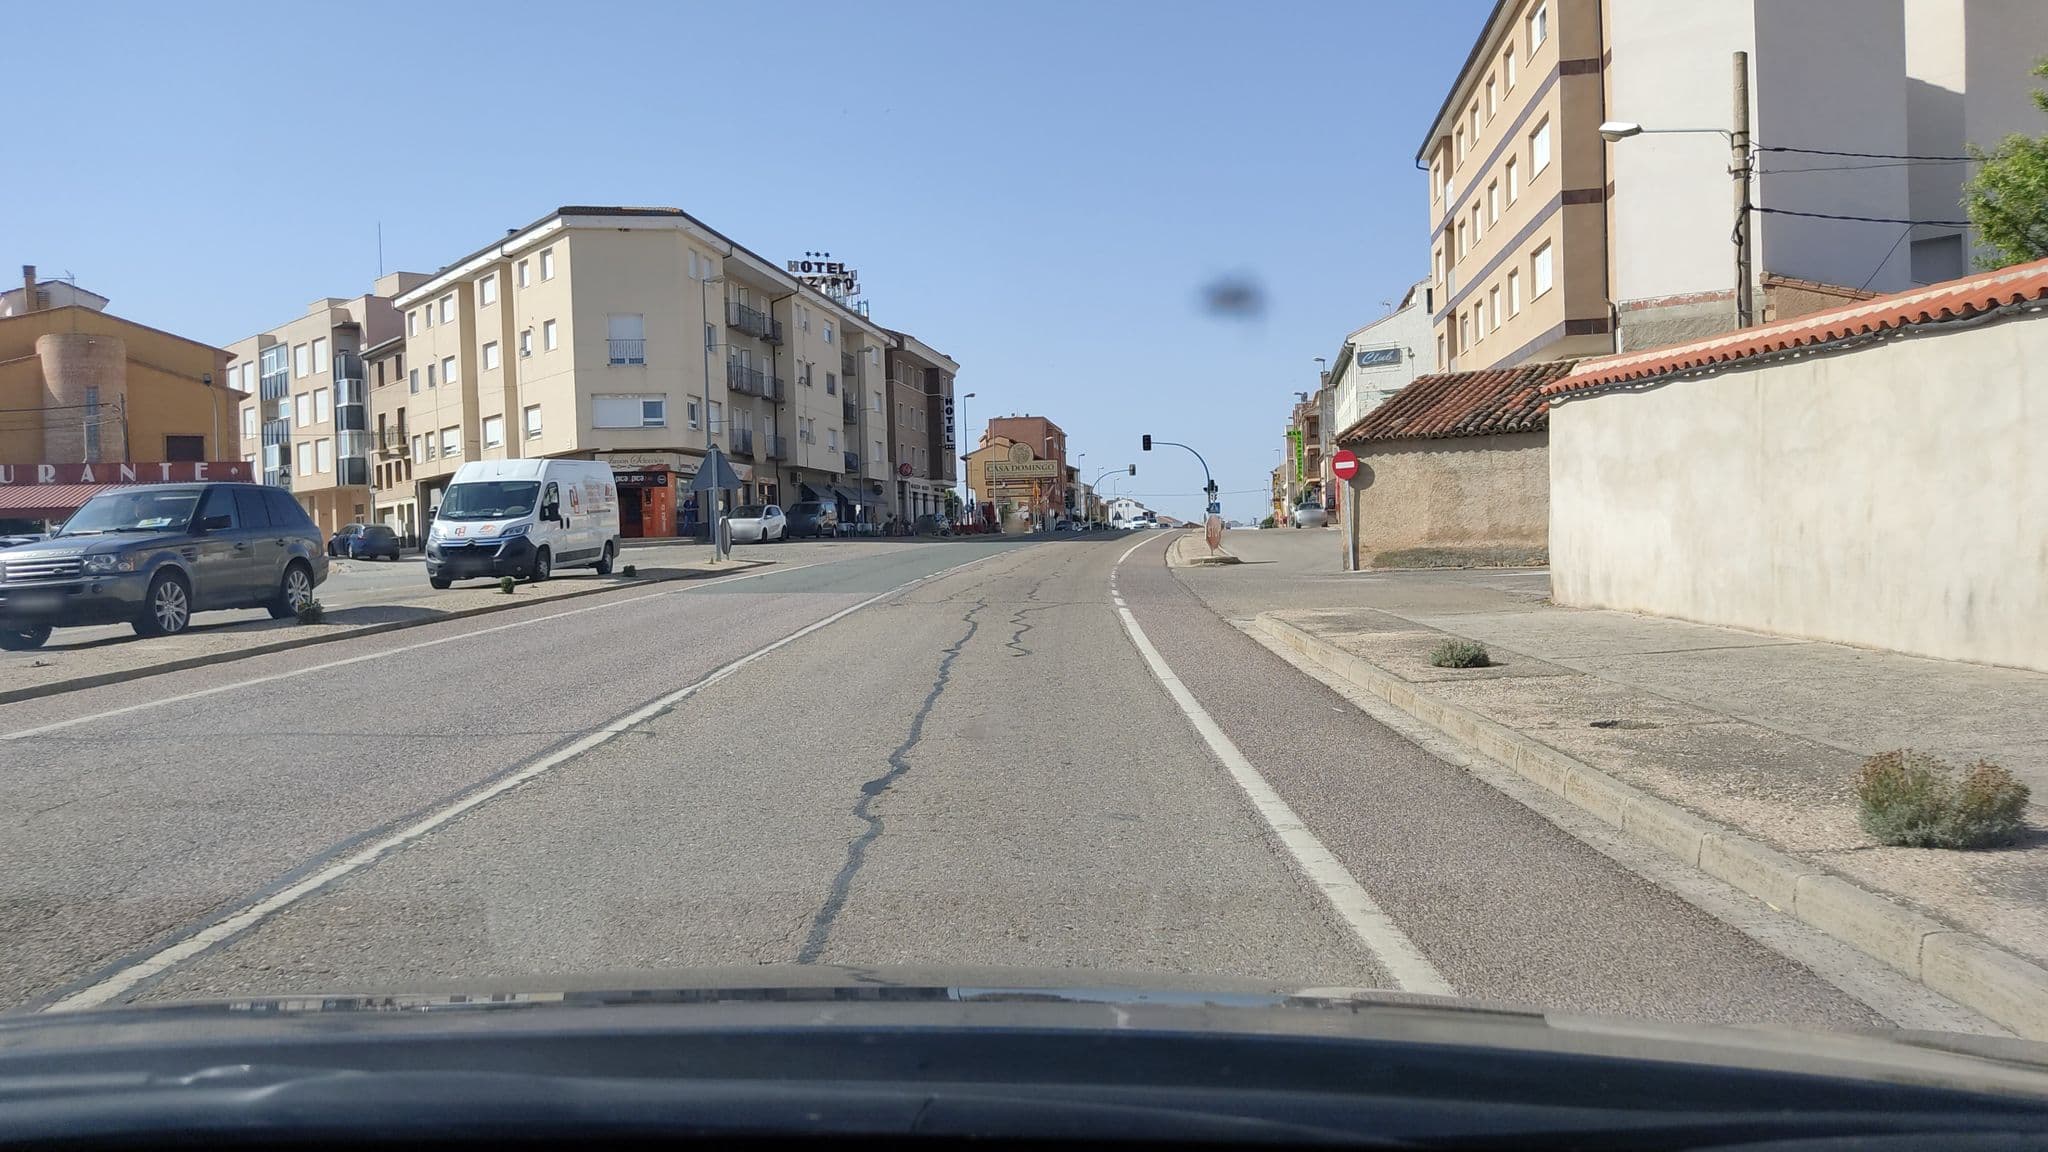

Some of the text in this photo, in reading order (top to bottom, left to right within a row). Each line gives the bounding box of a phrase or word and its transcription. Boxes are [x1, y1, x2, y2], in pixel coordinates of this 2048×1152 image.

[787, 260, 848, 275] HOTEL
[1361, 350, 1395, 365] Club
[945, 398, 953, 443] HOTEL
[0, 462, 209, 484] URANTE
[986, 463, 1055, 473] CASA DOMINGO
